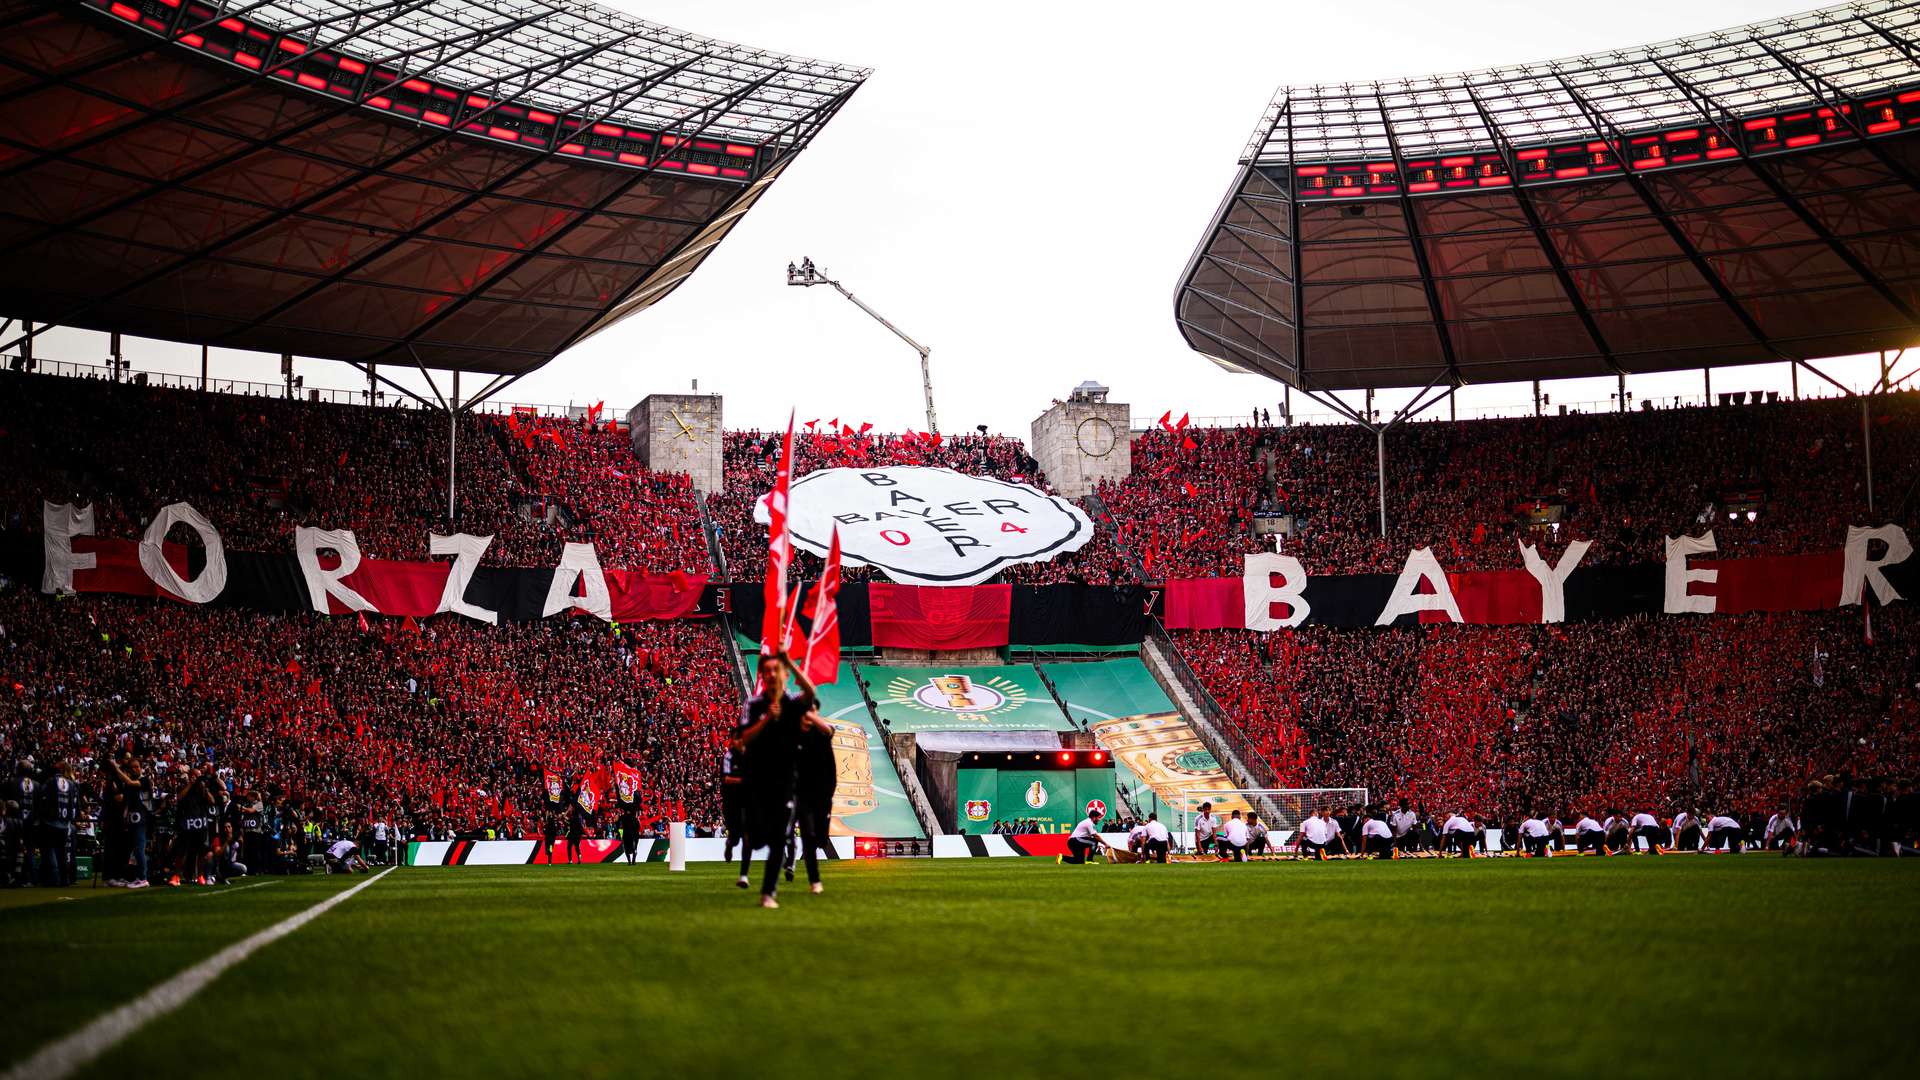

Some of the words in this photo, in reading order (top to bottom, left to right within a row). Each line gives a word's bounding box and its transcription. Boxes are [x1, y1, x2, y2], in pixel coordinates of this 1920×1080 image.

[833, 499, 1030, 525] BAYER
[860, 472, 991, 557] BAYER
[41, 500, 612, 625] FORZA
[1243, 523, 1914, 632] BAYER
